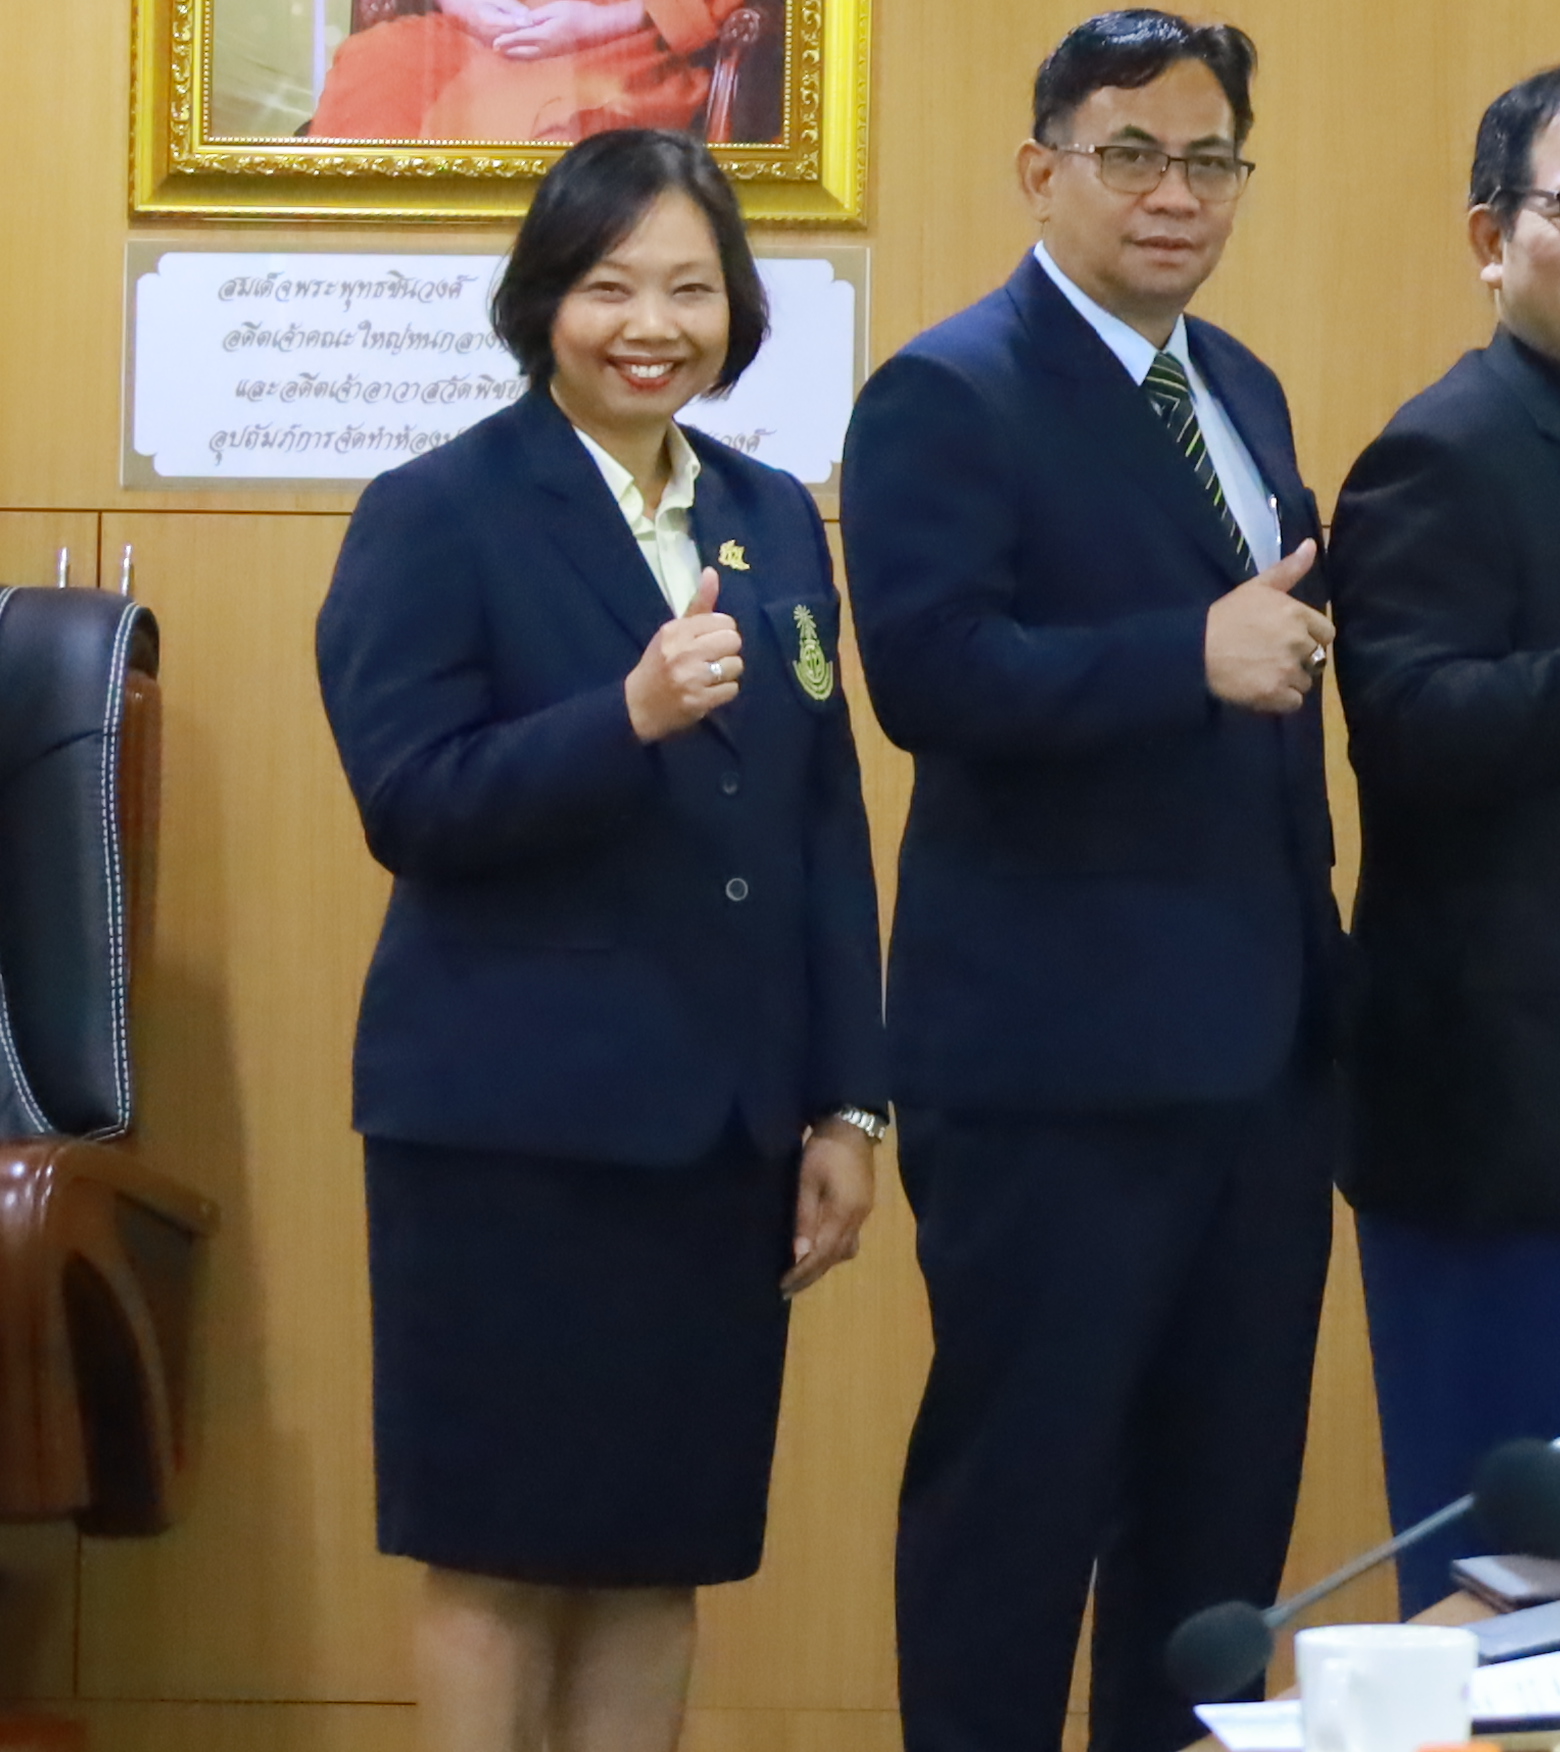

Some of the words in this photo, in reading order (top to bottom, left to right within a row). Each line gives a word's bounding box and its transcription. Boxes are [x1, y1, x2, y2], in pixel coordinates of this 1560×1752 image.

[222, 319, 507, 355] อดีตเจ้าคณะใหญ่หนกลาง
[209, 422, 466, 466] อุปถัมภ์การจัดทำห้อง
